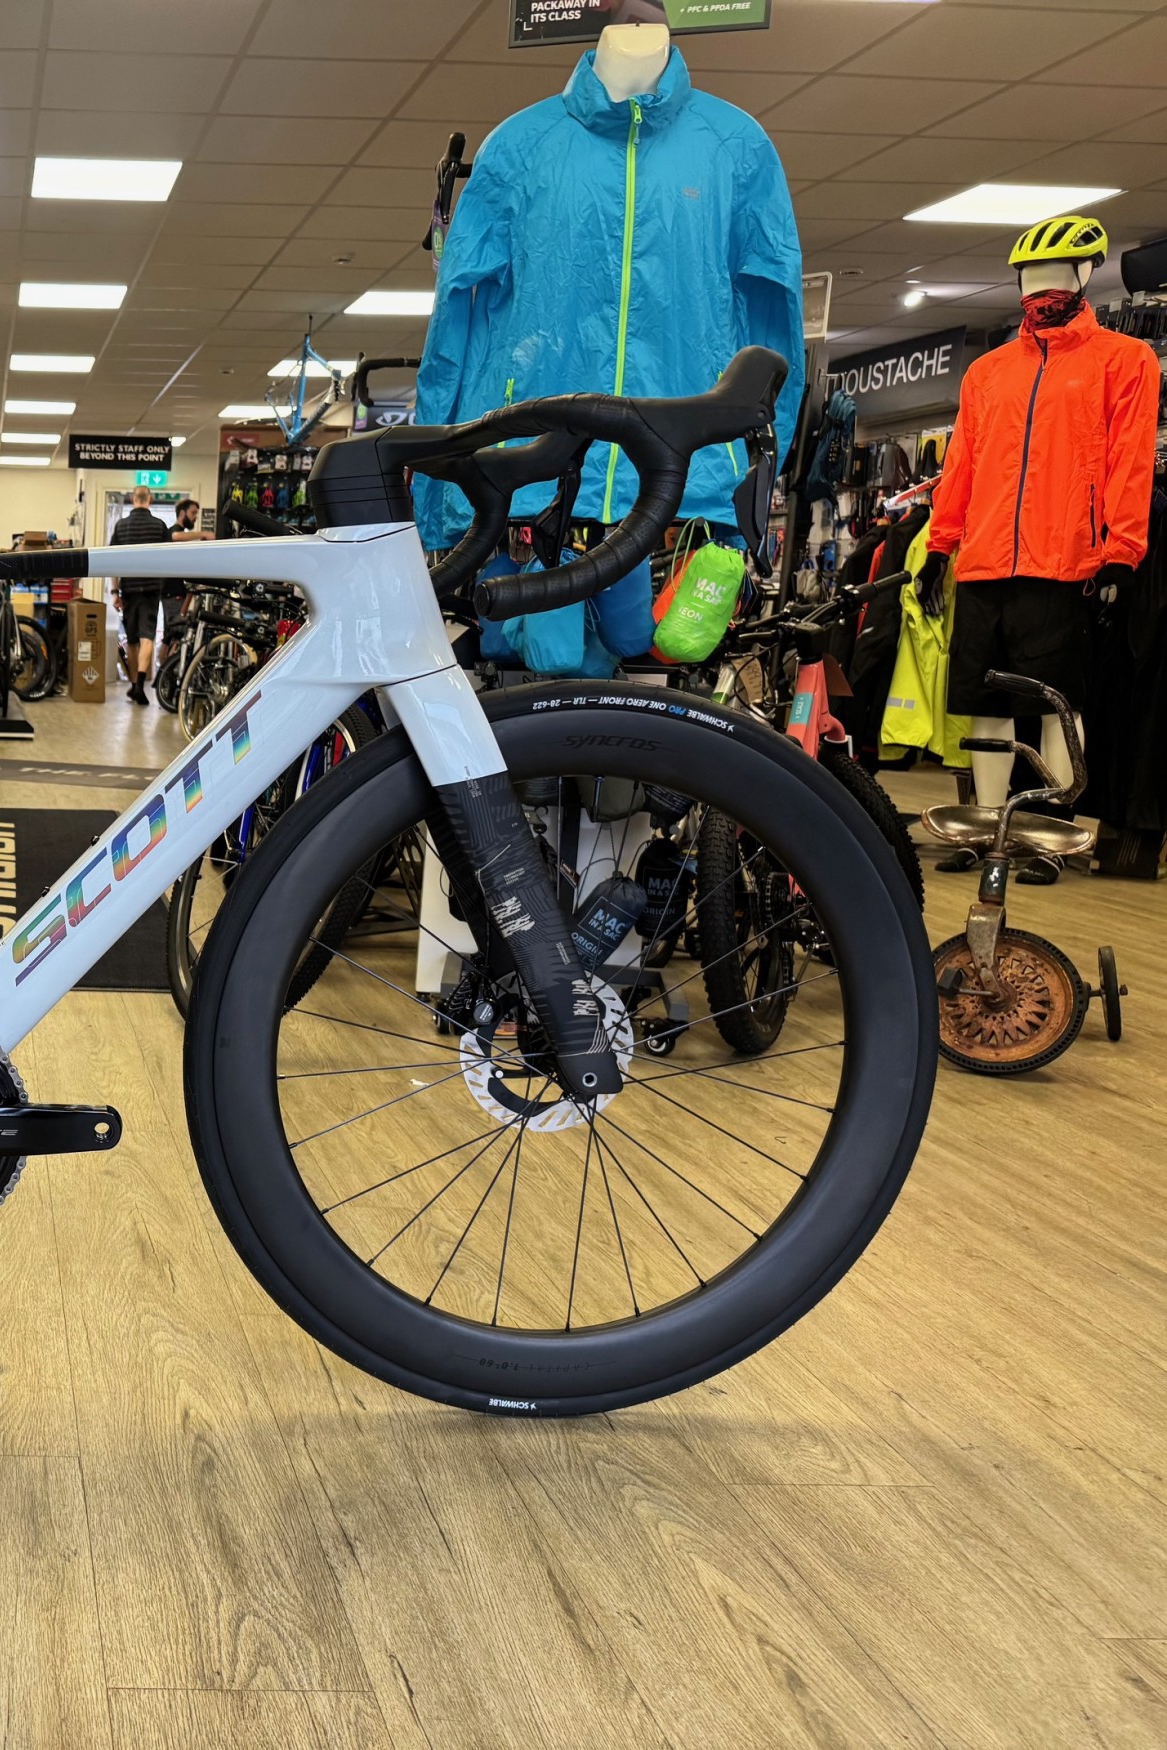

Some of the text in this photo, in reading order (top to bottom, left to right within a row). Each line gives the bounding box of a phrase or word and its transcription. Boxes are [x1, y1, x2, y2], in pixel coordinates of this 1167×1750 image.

[531, 0, 585, 12] PACKAWAY
[687, 2, 751, 13] PFC & PFOA FREE
[531, 10, 582, 23] ITS CLASS
[75, 443, 170, 454] STRICTLY STAFF ONLY
[80, 452, 165, 462] BEYOND THIS POINT
[532, 696, 727, 730] SCHWALBE PRO ONE AERO FRONT TLR 28-622
[12, 689, 262, 987] SCOTT
[594, 908, 626, 934] MAC
[588, 918, 599, 929] IN
[603, 928, 621, 941] SAC
[571, 931, 603, 956] ORIGIN
[488, 1397, 530, 1410] SCHWALBE
